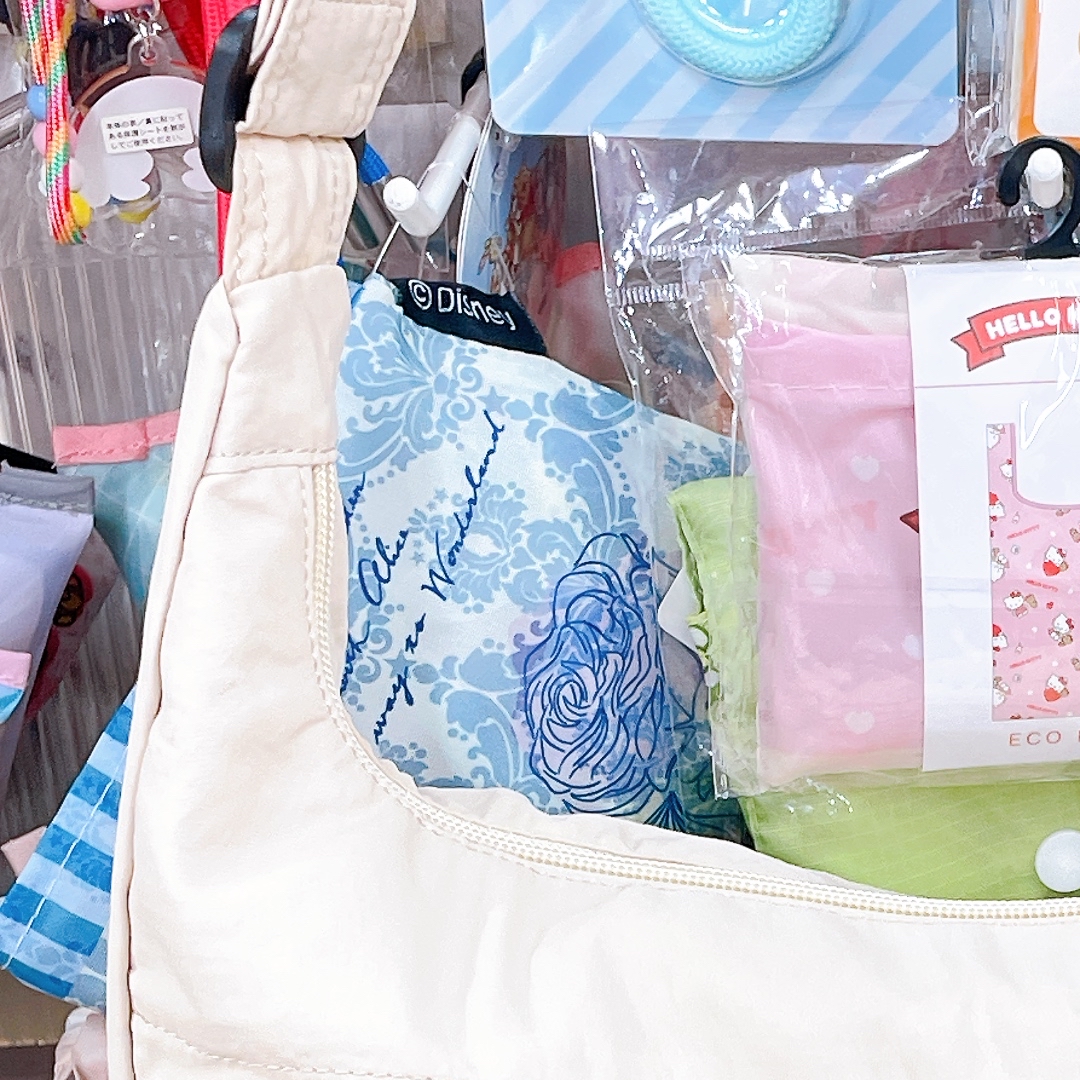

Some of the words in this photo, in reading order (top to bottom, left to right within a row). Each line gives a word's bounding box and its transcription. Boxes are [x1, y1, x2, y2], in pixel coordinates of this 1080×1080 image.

[984, 306, 1061, 341] HELLO
[420, 409, 505, 601] Wonderland
[358, 529, 409, 607] Alice
[1008, 730, 1062, 747] ECO
